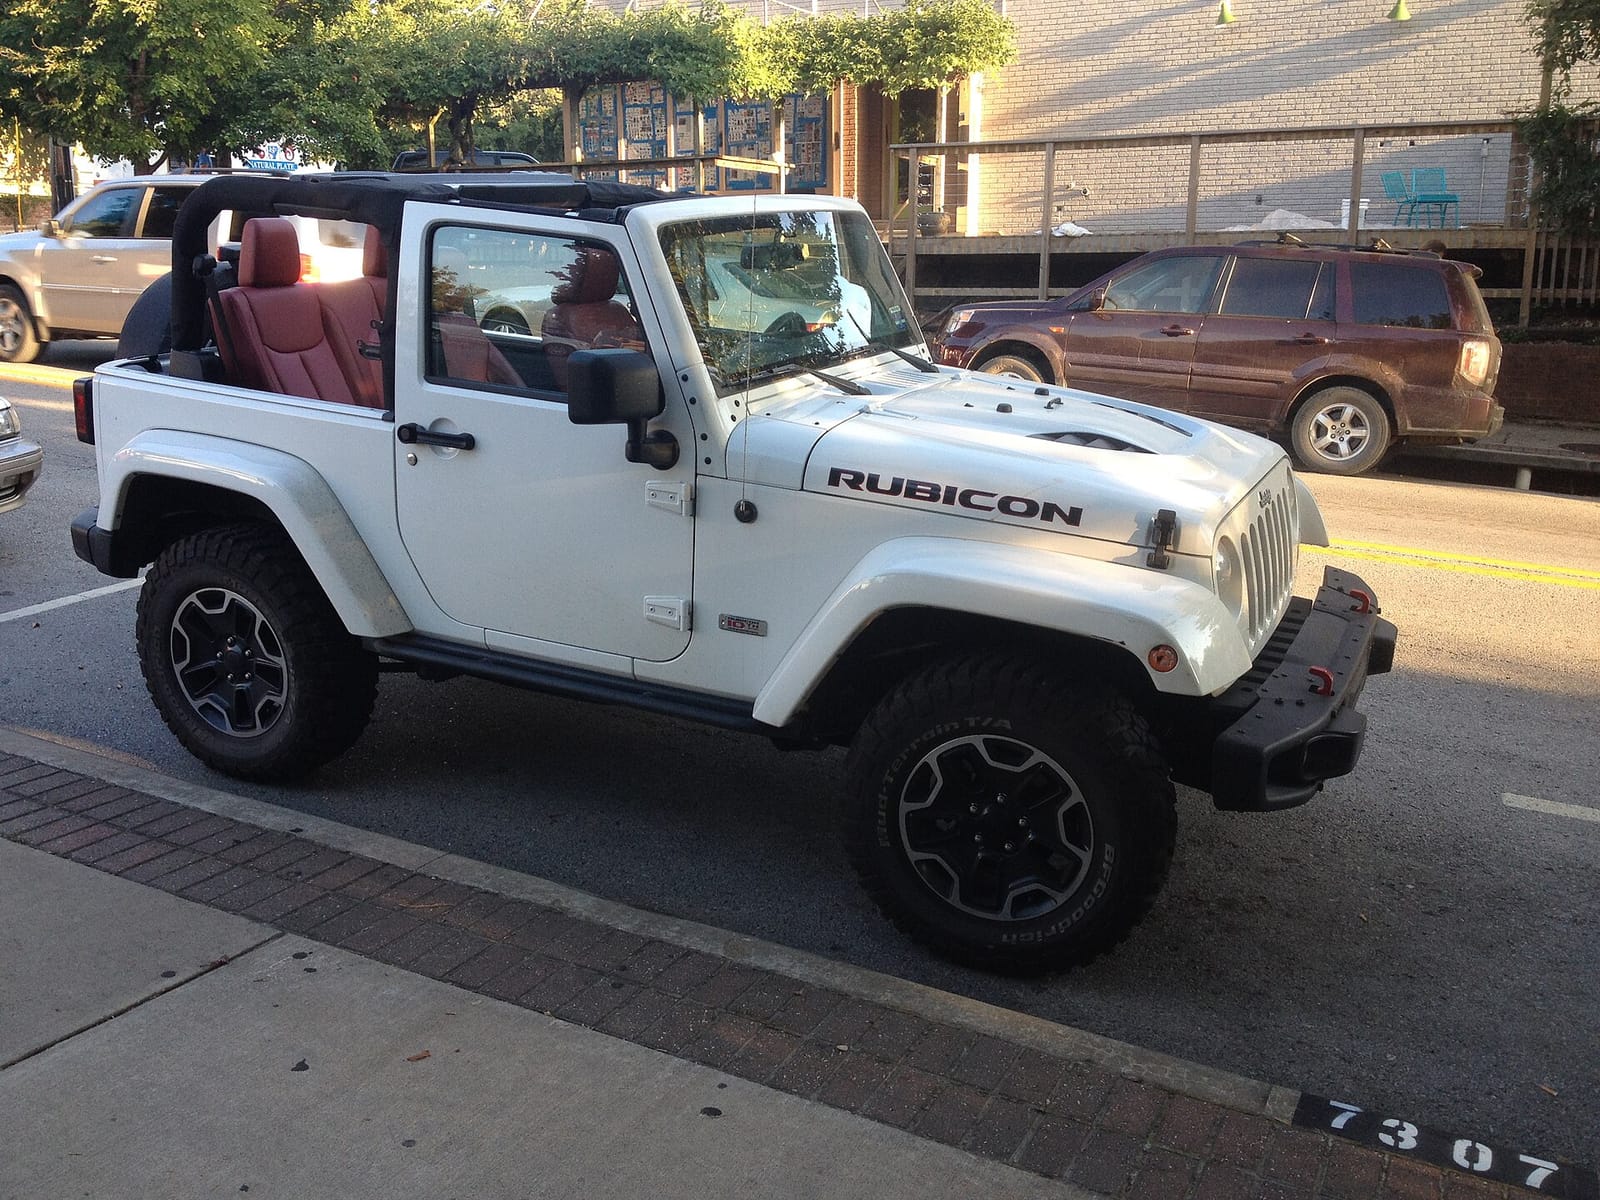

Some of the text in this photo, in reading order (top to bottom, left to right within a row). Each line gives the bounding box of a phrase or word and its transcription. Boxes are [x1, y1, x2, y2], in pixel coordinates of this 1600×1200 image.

[248, 160, 277, 170] NATURAL
[828, 467, 1083, 527] RUBICON
[964, 715, 1013, 730] T/A
